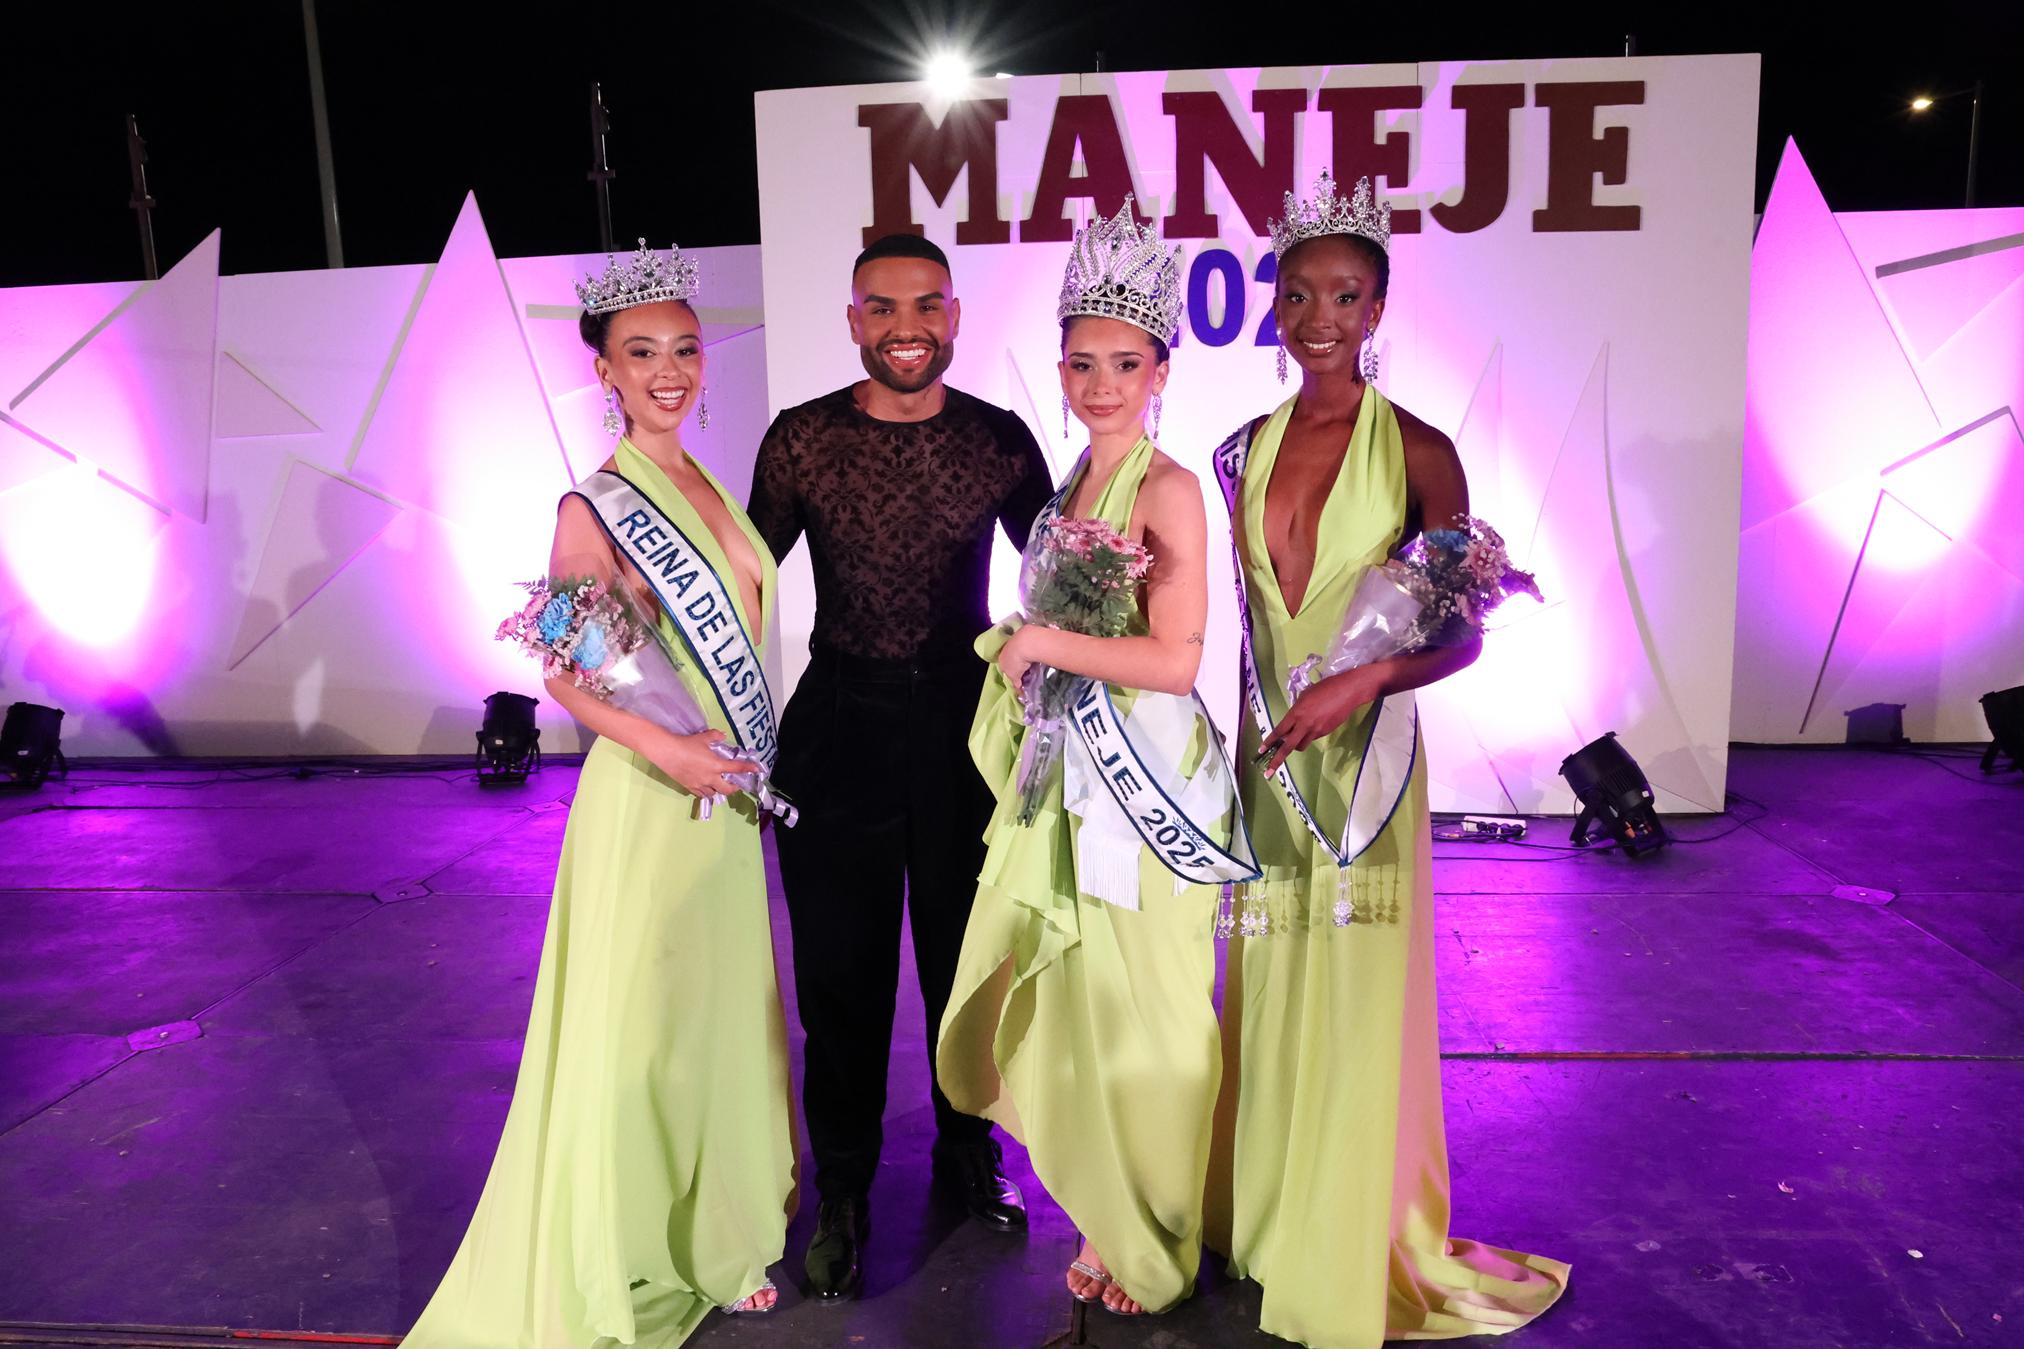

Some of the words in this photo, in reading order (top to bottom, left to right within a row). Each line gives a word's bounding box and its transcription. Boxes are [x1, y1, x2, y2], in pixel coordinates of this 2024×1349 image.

[858, 79, 1646, 249] MANEJE
[617, 509, 700, 599] REINA
[685, 591, 728, 642] DE
[711, 636, 755, 696] LAS
[1140, 808, 1215, 868] 2025
